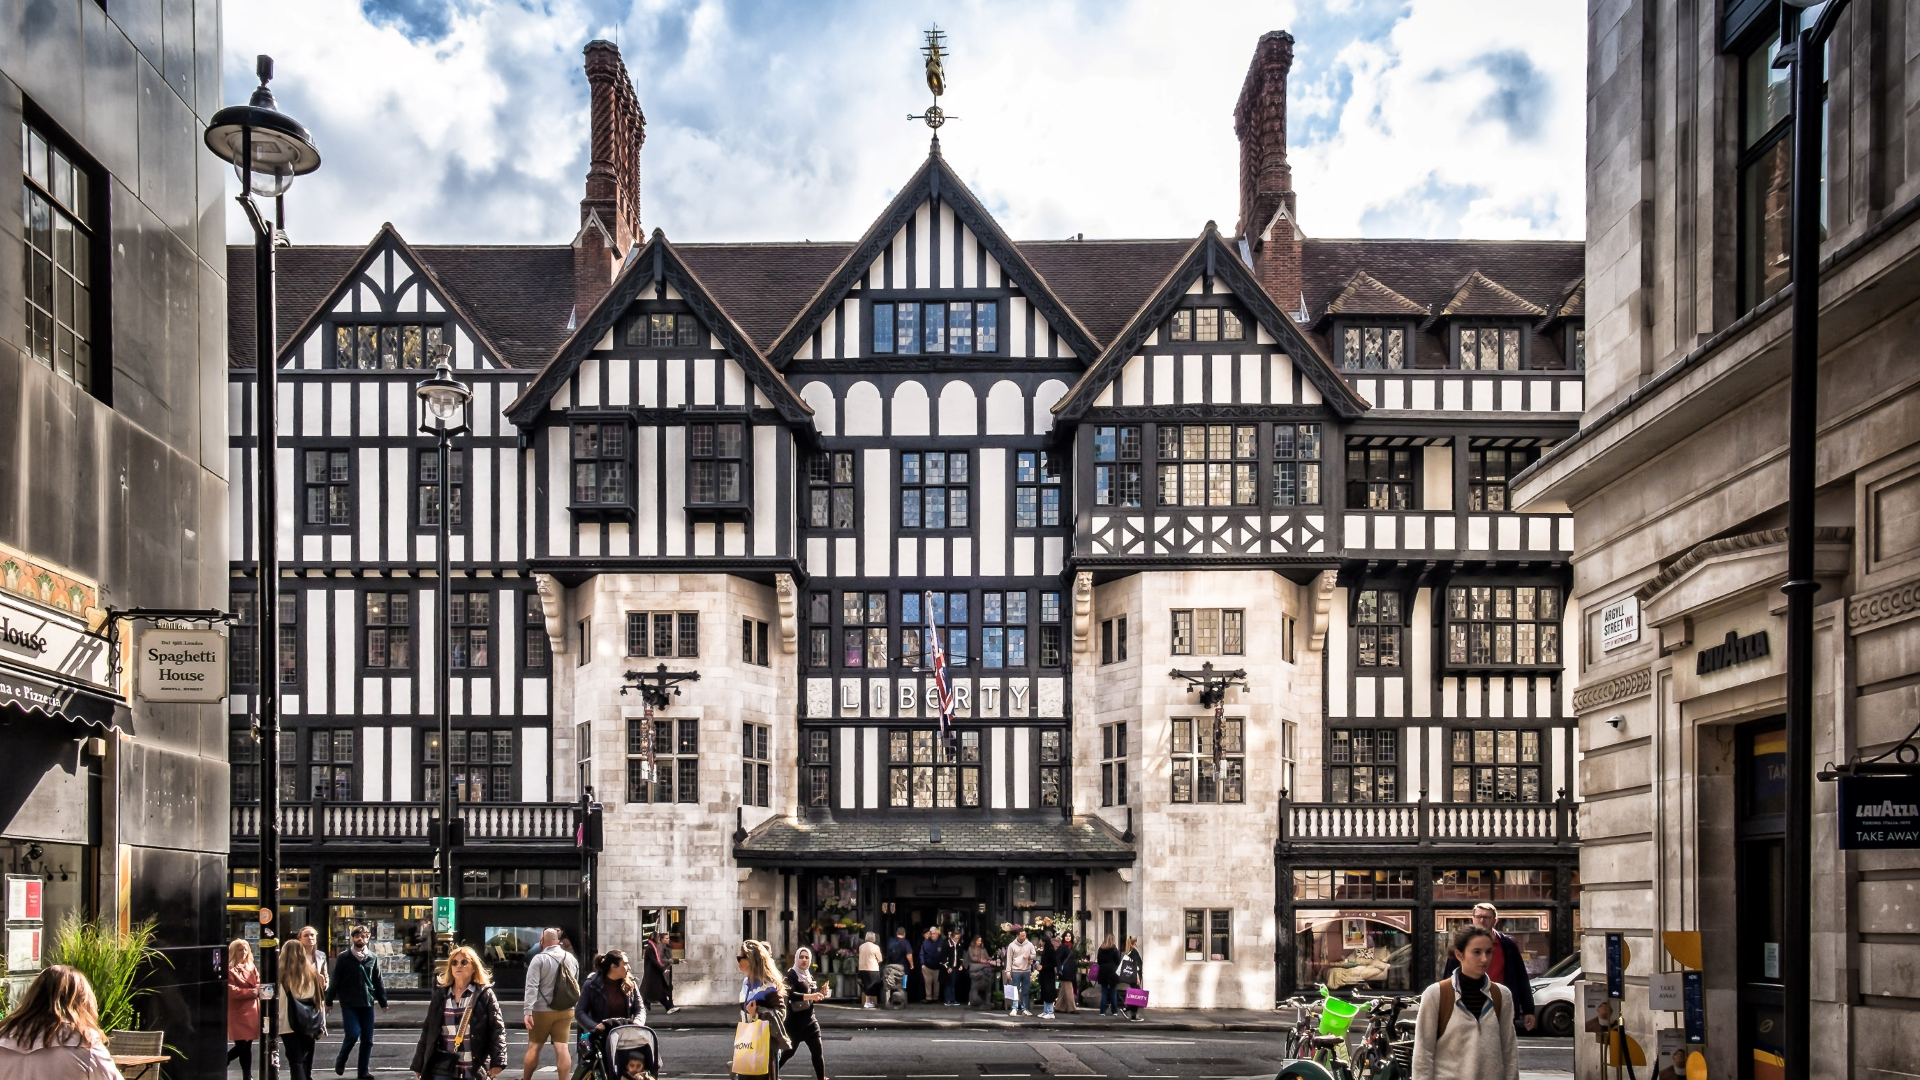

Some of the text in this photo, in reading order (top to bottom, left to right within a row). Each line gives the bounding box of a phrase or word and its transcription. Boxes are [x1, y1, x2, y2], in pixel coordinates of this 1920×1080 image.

[1605, 605, 1625, 622] ARGYLL
[1604, 615, 1634, 636] STREET W1
[148, 648, 217, 666] Spaghetti
[1696, 631, 1769, 676] LAVAZZA
[159, 668, 205, 682] House
[15, 687, 22, 697] e
[23, 686, 61, 707] Pizzeria
[842, 685, 1030, 710] LIBERTY
[1855, 800, 1920, 817] LAVAZZA
[1856, 831, 1920, 842] TAKE AWAY
[1126, 993, 1148, 1001] LIBERTY
